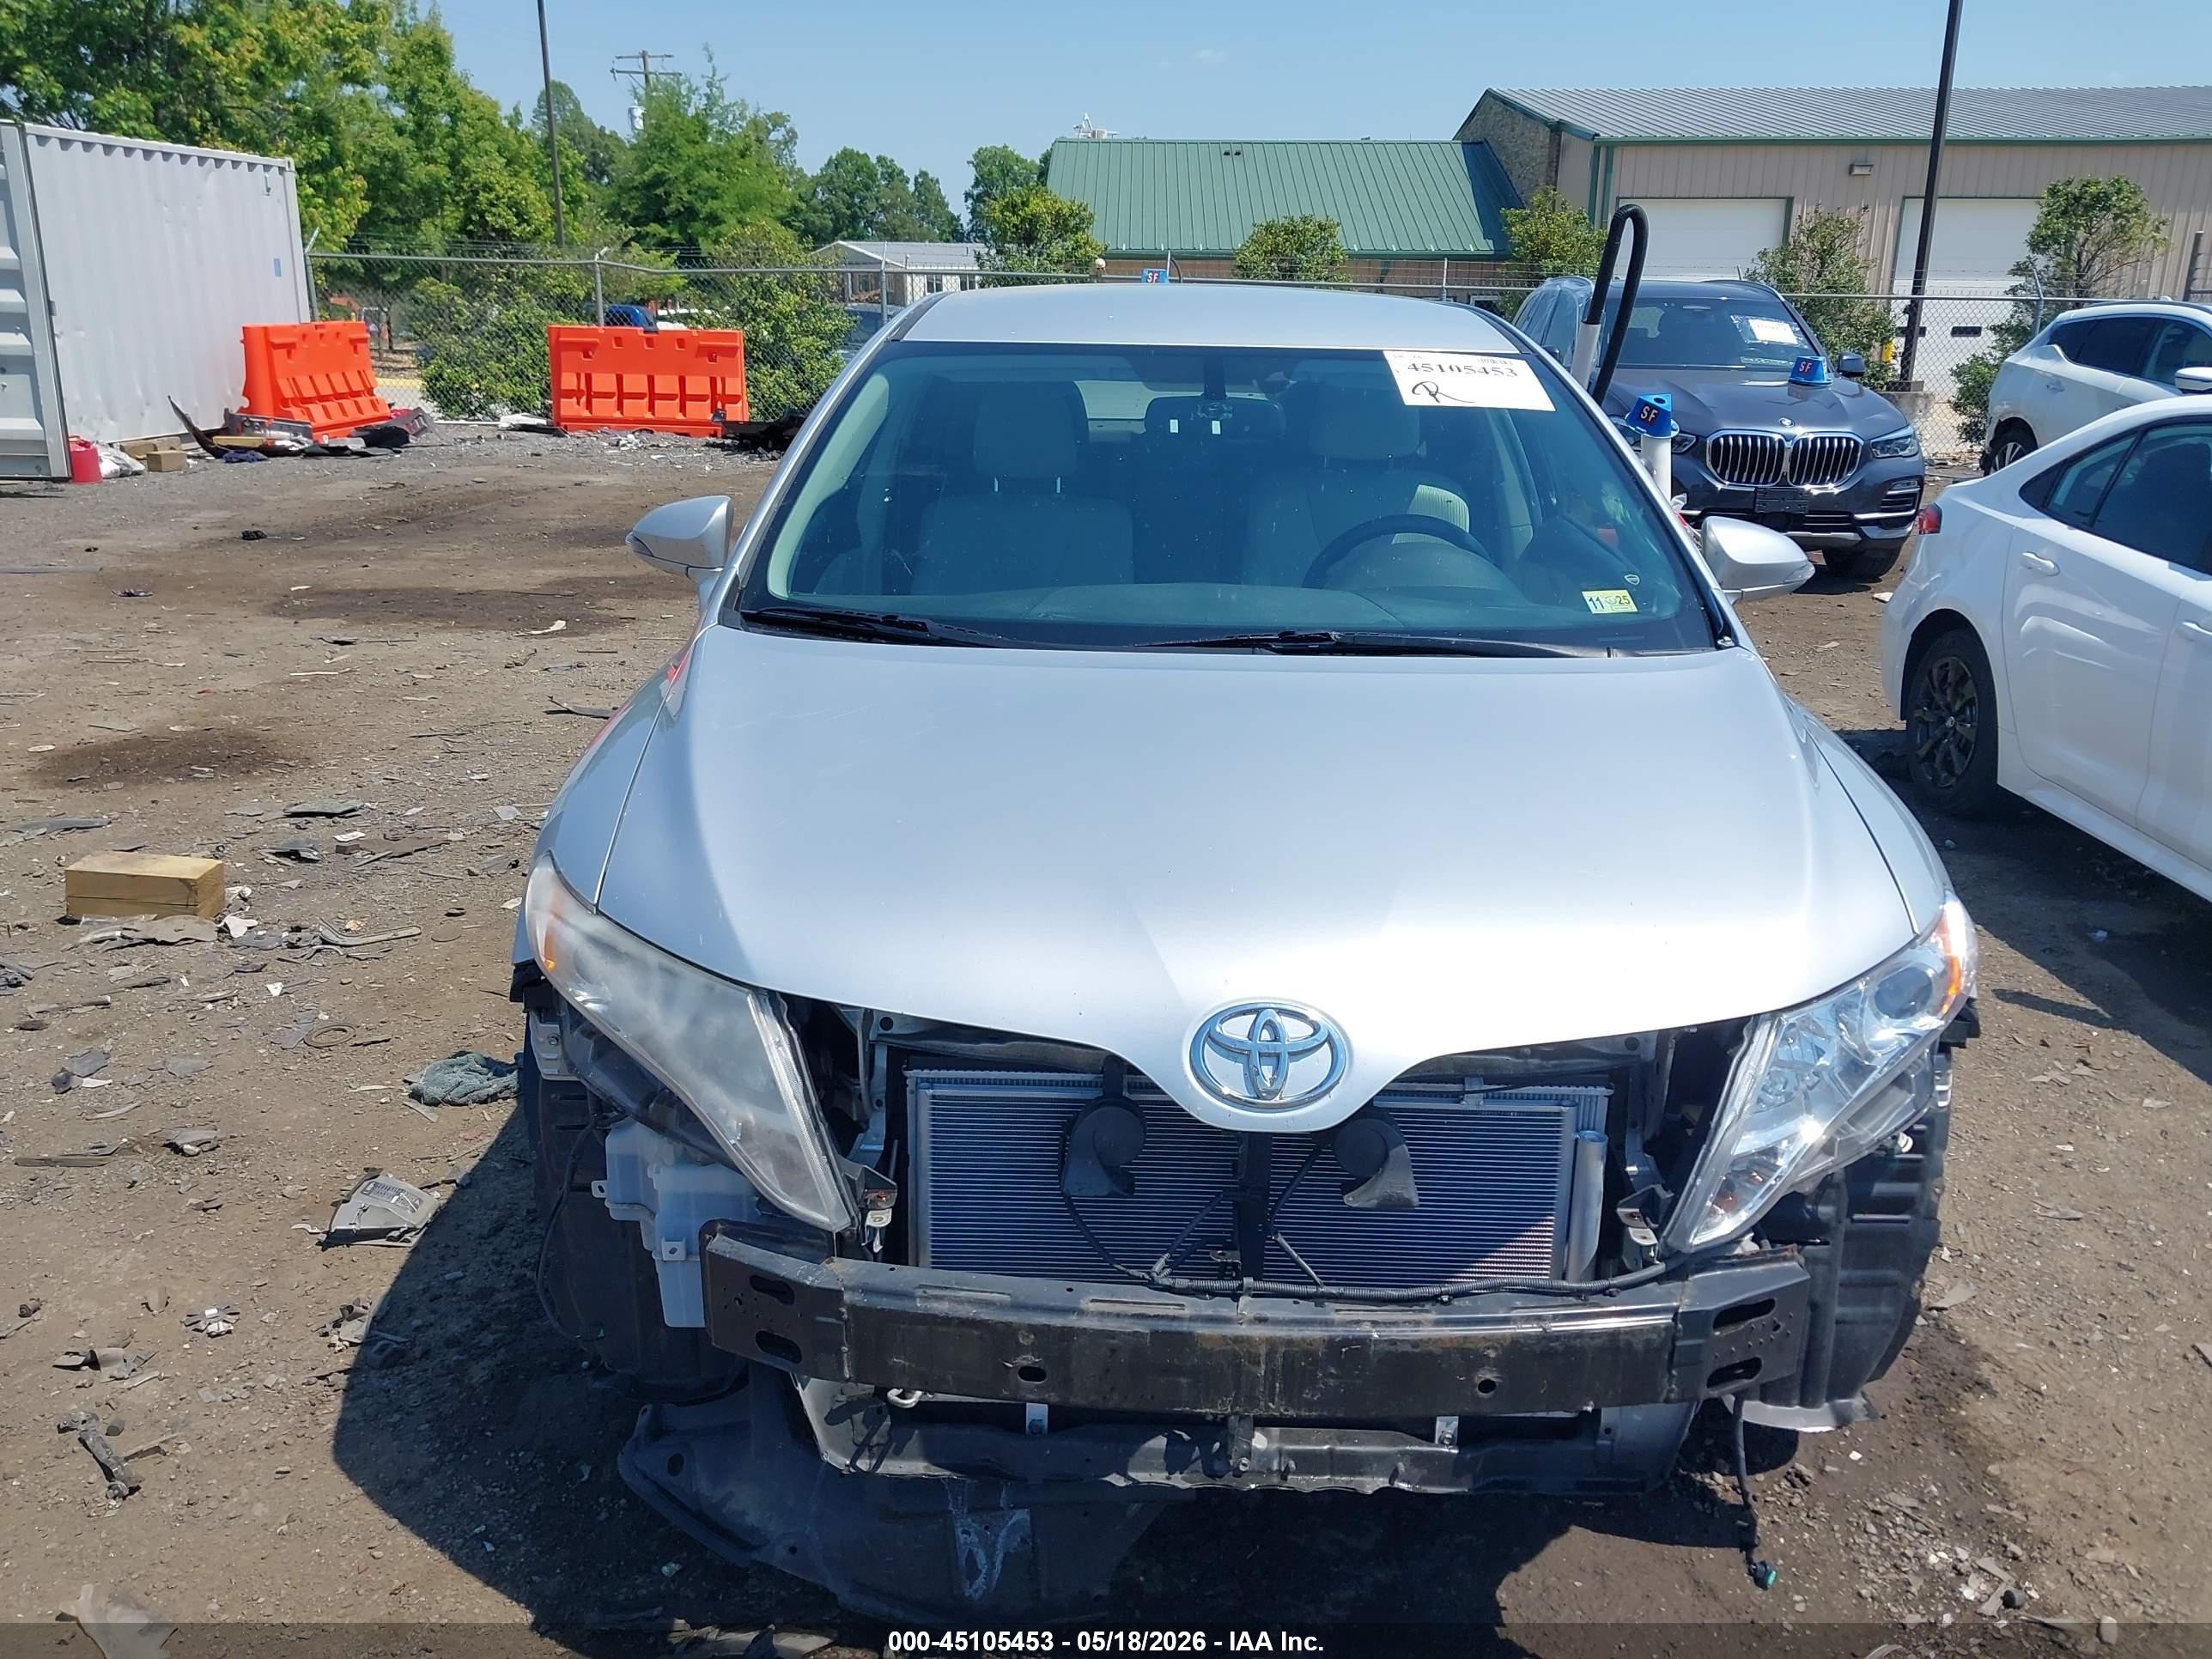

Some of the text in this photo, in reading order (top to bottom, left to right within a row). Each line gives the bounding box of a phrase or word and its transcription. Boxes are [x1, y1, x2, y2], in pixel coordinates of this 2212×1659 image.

[1147, 272, 1159, 283] SF
[1407, 362, 1518, 377] 45105453
[1799, 362, 1812, 373] SF
[1640, 405, 1658, 422] SF
[1589, 595, 1631, 610] 11 25
